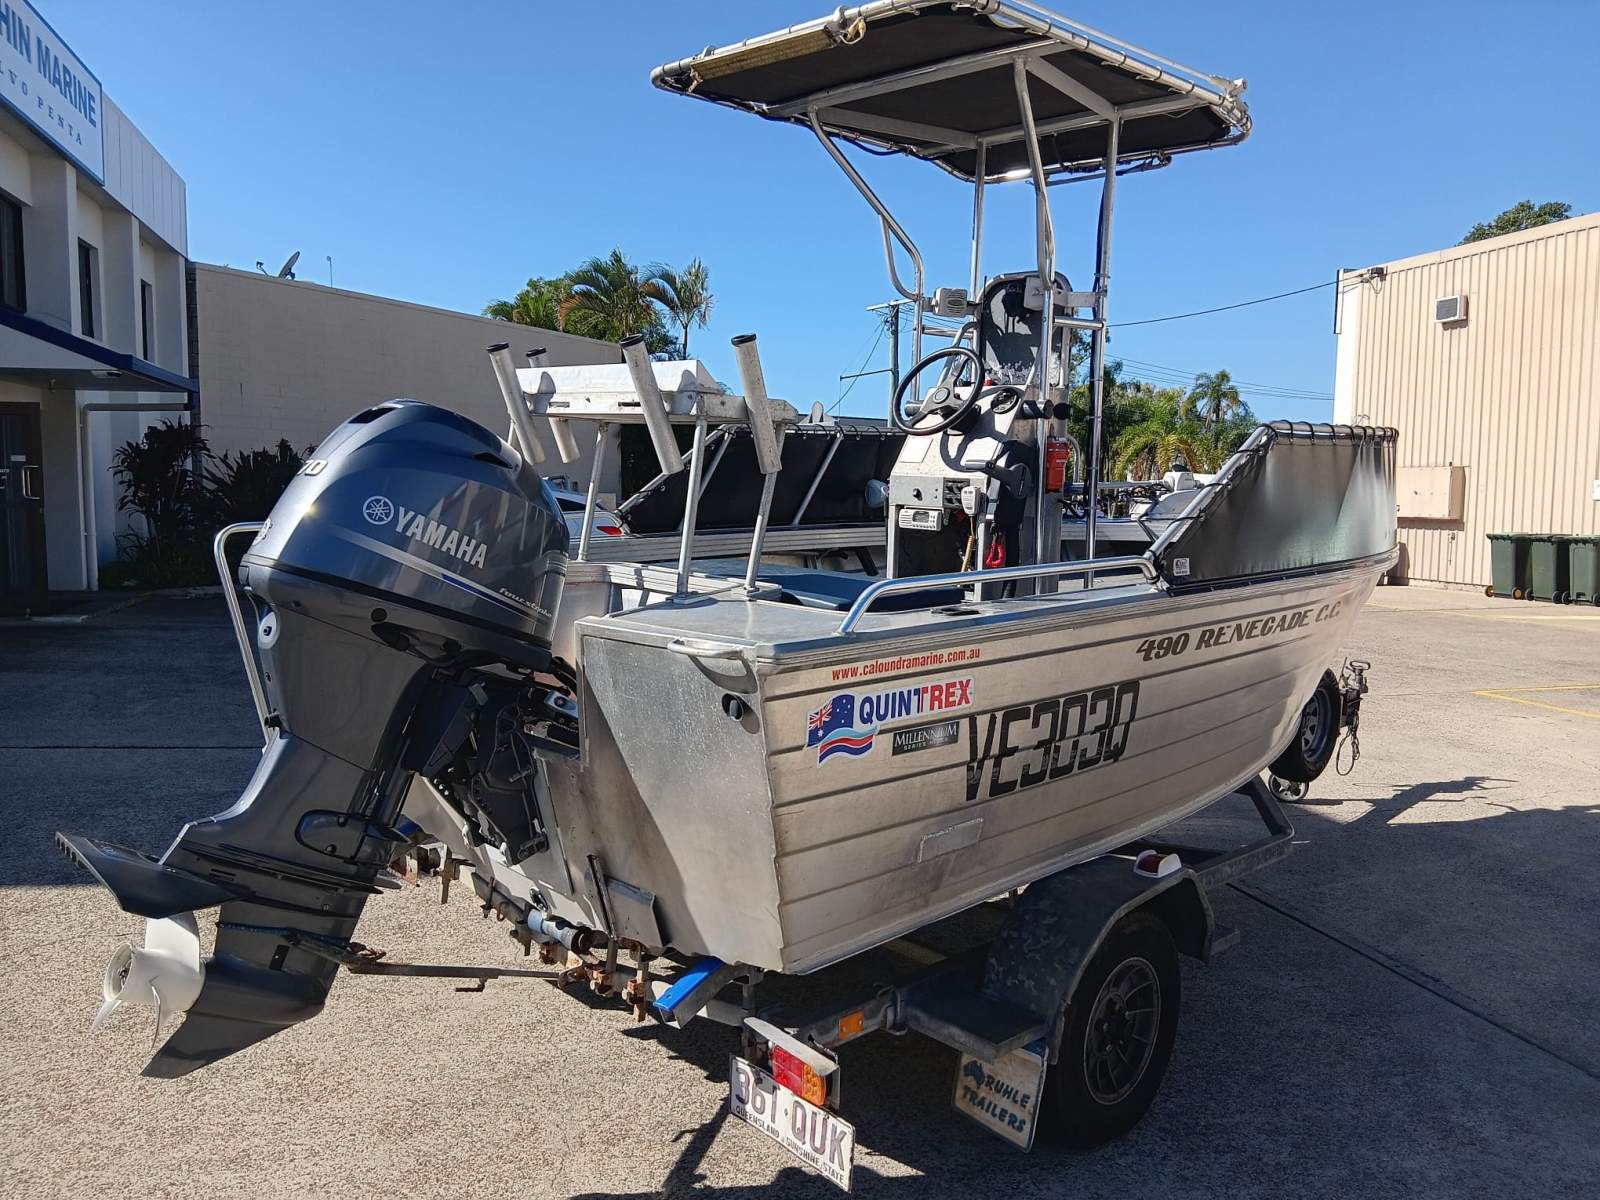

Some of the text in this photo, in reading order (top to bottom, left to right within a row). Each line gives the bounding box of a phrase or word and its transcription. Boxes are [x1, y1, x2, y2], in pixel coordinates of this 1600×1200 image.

[36, 36, 97, 128] MARINE
[37, 95, 82, 145] PENTA
[396, 507, 489, 569] YAMAHA
[1136, 632, 1190, 661] 490
[1195, 608, 1314, 650] RENEGADE
[832, 648, 980, 681] www.caloundramarine.com.au
[860, 679, 971, 724] QUINTREX
[963, 1085, 1026, 1133] TRAILERS
[985, 1074, 1031, 1109] RUHLE
[735, 1104, 780, 1139] QUEENSLAND
[822, 1162, 845, 1184] STATE
[791, 1099, 848, 1172] QUK
